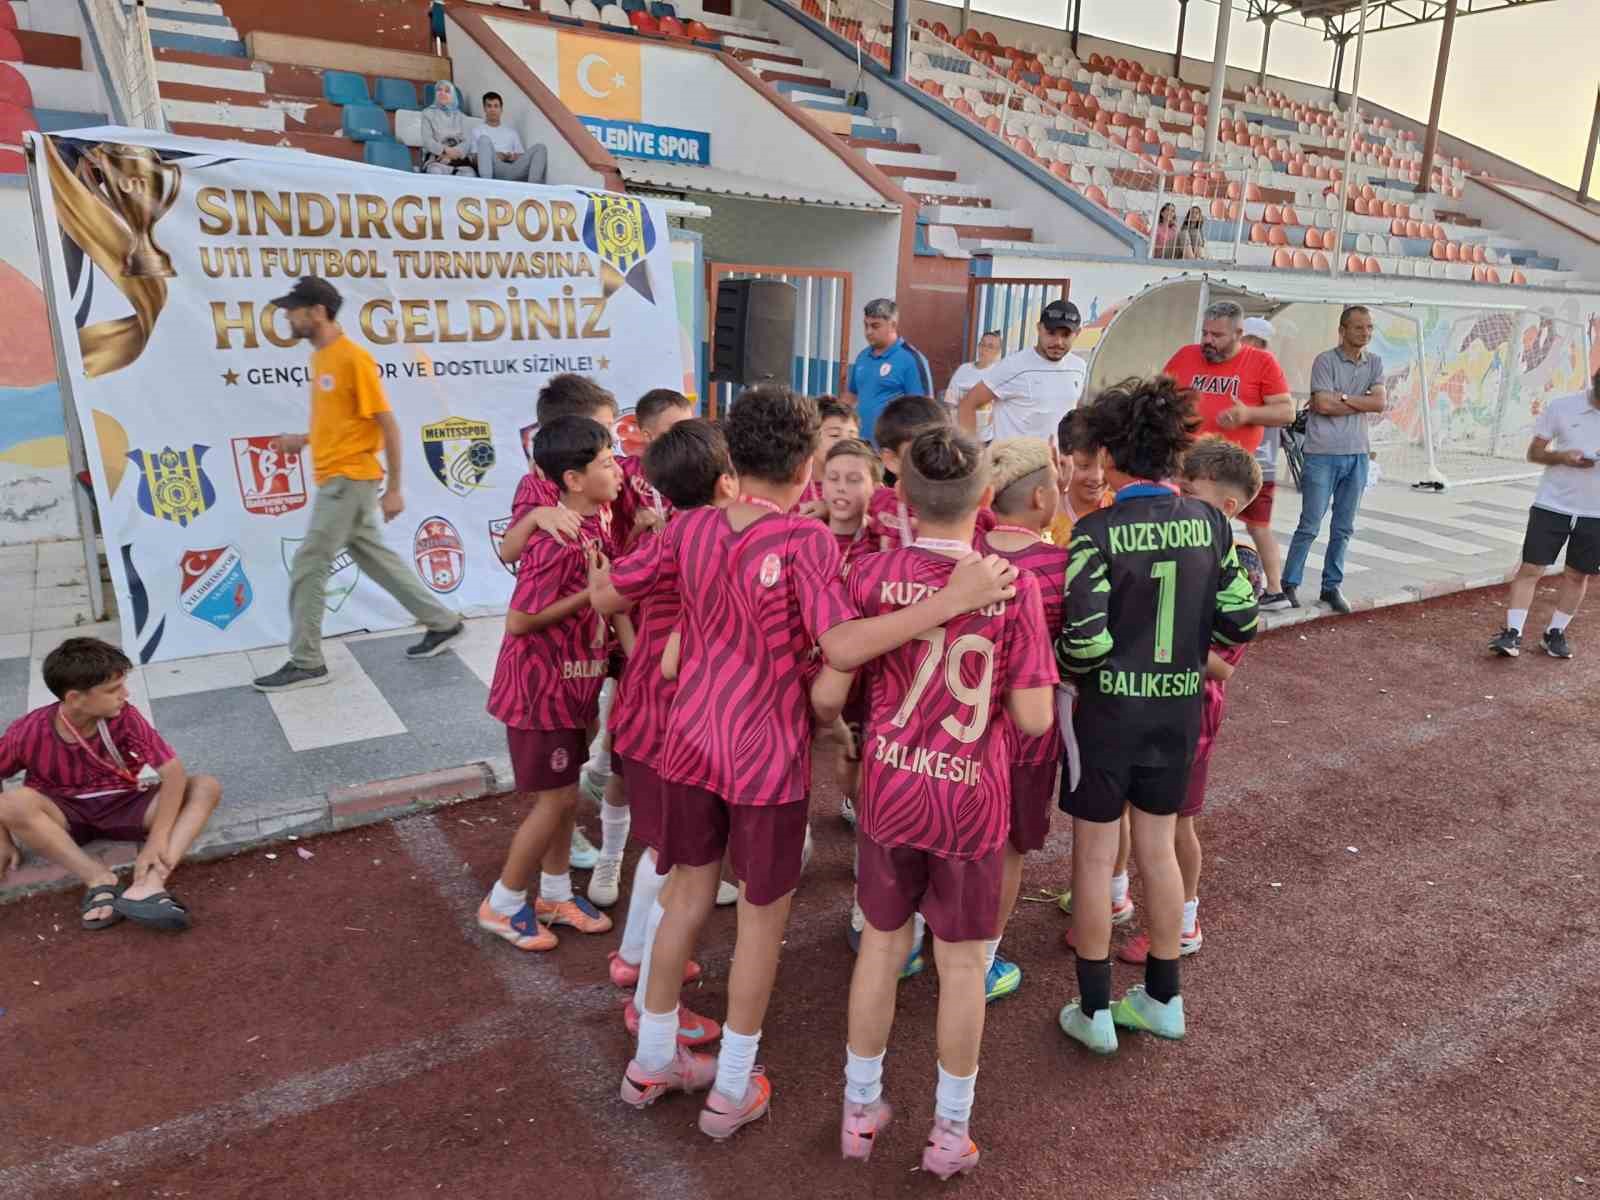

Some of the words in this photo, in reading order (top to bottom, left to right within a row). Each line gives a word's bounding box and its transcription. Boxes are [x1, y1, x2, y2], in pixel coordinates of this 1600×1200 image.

[584, 124, 655, 154] ELEDİYE
[658, 134, 699, 161] SPOR
[195, 187, 444, 240] SINDIRGI
[456, 197, 580, 242] SPOR
[199, 246, 252, 278] U11
[258, 247, 387, 278] FUTBOL
[393, 250, 595, 279] TURNUVASINA
[209, 301, 302, 350] HO
[359, 285, 611, 345] GELDİNİZ
[247, 366, 314, 388] GENÇL
[402, 361, 428, 378] VE
[433, 359, 519, 377] DOSTLUK
[522, 353, 593, 374] SİZİNLE!
[1108, 519, 1212, 554] KUZEYORDU
[1150, 560, 1177, 664] 1
[890, 625, 996, 744] 79
[1100, 668, 1200, 698] BALIKESİR
